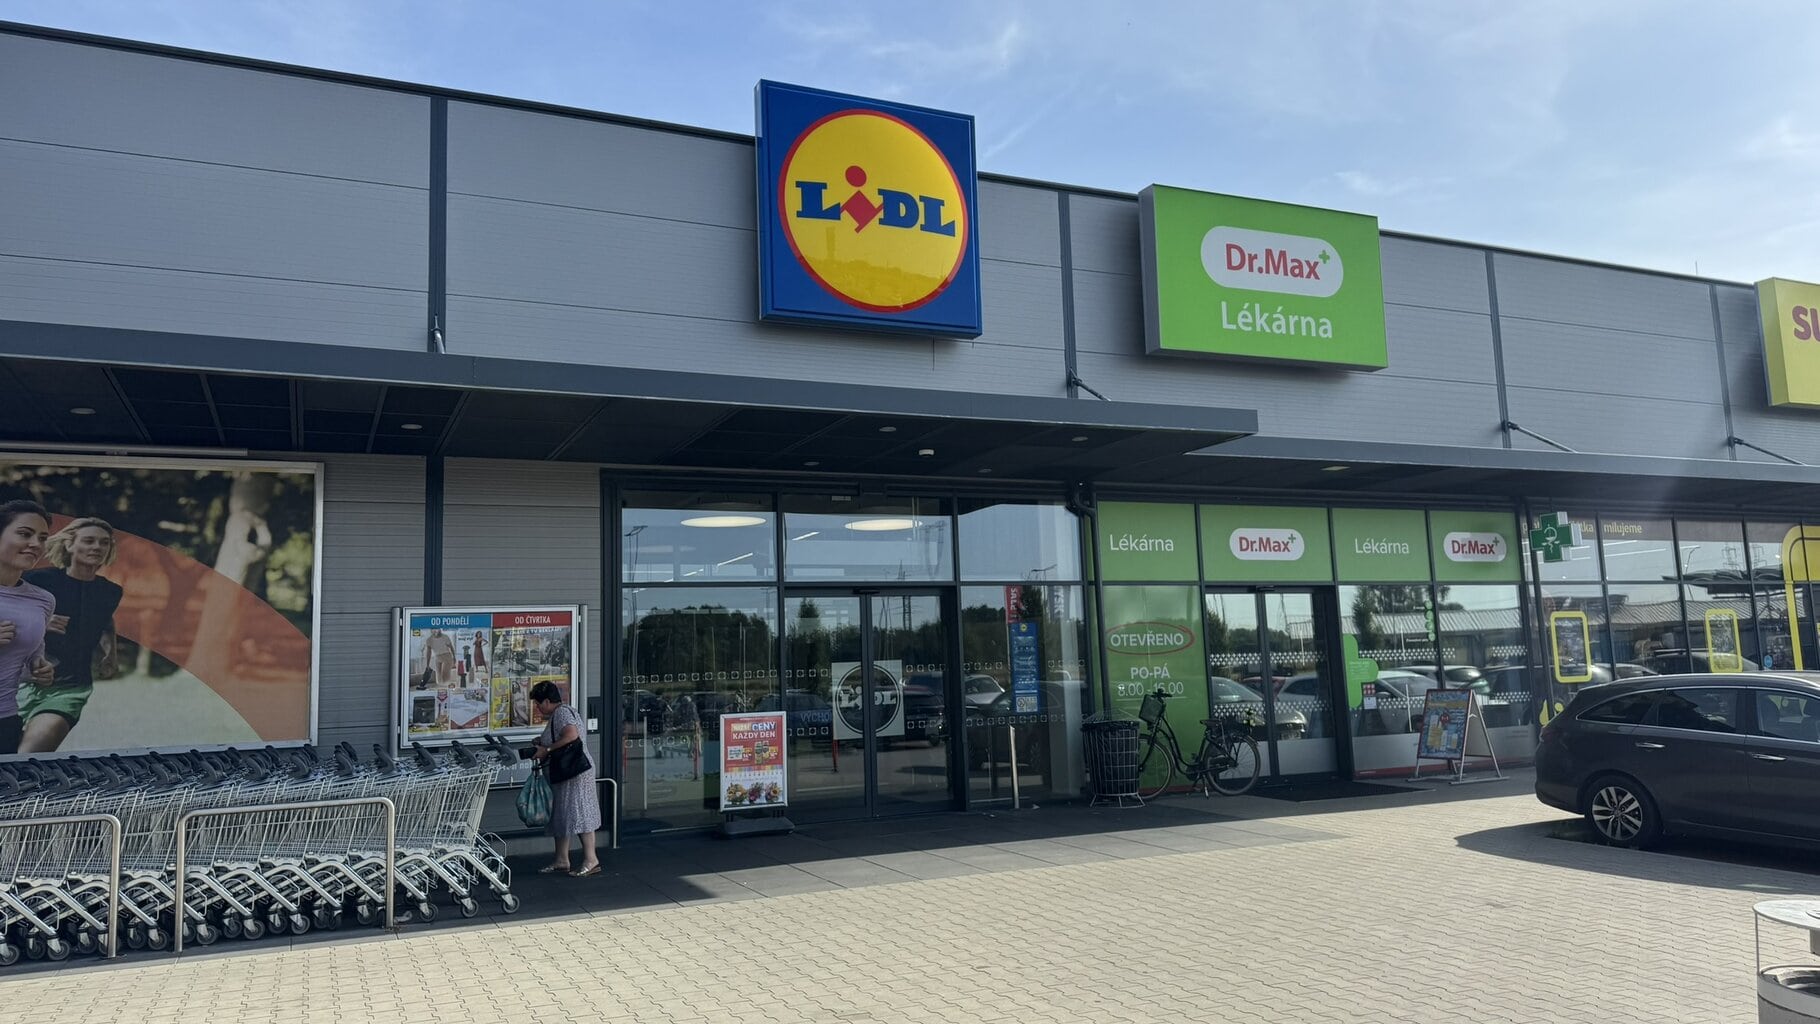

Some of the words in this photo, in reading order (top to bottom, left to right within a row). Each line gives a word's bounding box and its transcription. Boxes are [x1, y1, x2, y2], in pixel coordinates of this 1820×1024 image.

[795, 165, 956, 237] LIDL
[1220, 300, 1334, 339] Lékárna
[1603, 521, 1642, 536] milujeme
[1109, 533, 1174, 552] Lékárna
[1354, 537, 1410, 555] Lékárna
[430, 617, 441, 626] OD
[514, 616, 525, 625] OD
[525, 614, 551, 624] ČTVRTKA
[1110, 631, 1184, 647] OTEVŘENO
[1130, 662, 1171, 680] PO-PÁ
[752, 721, 776, 731] CENY
[759, 730, 776, 739] DEN
